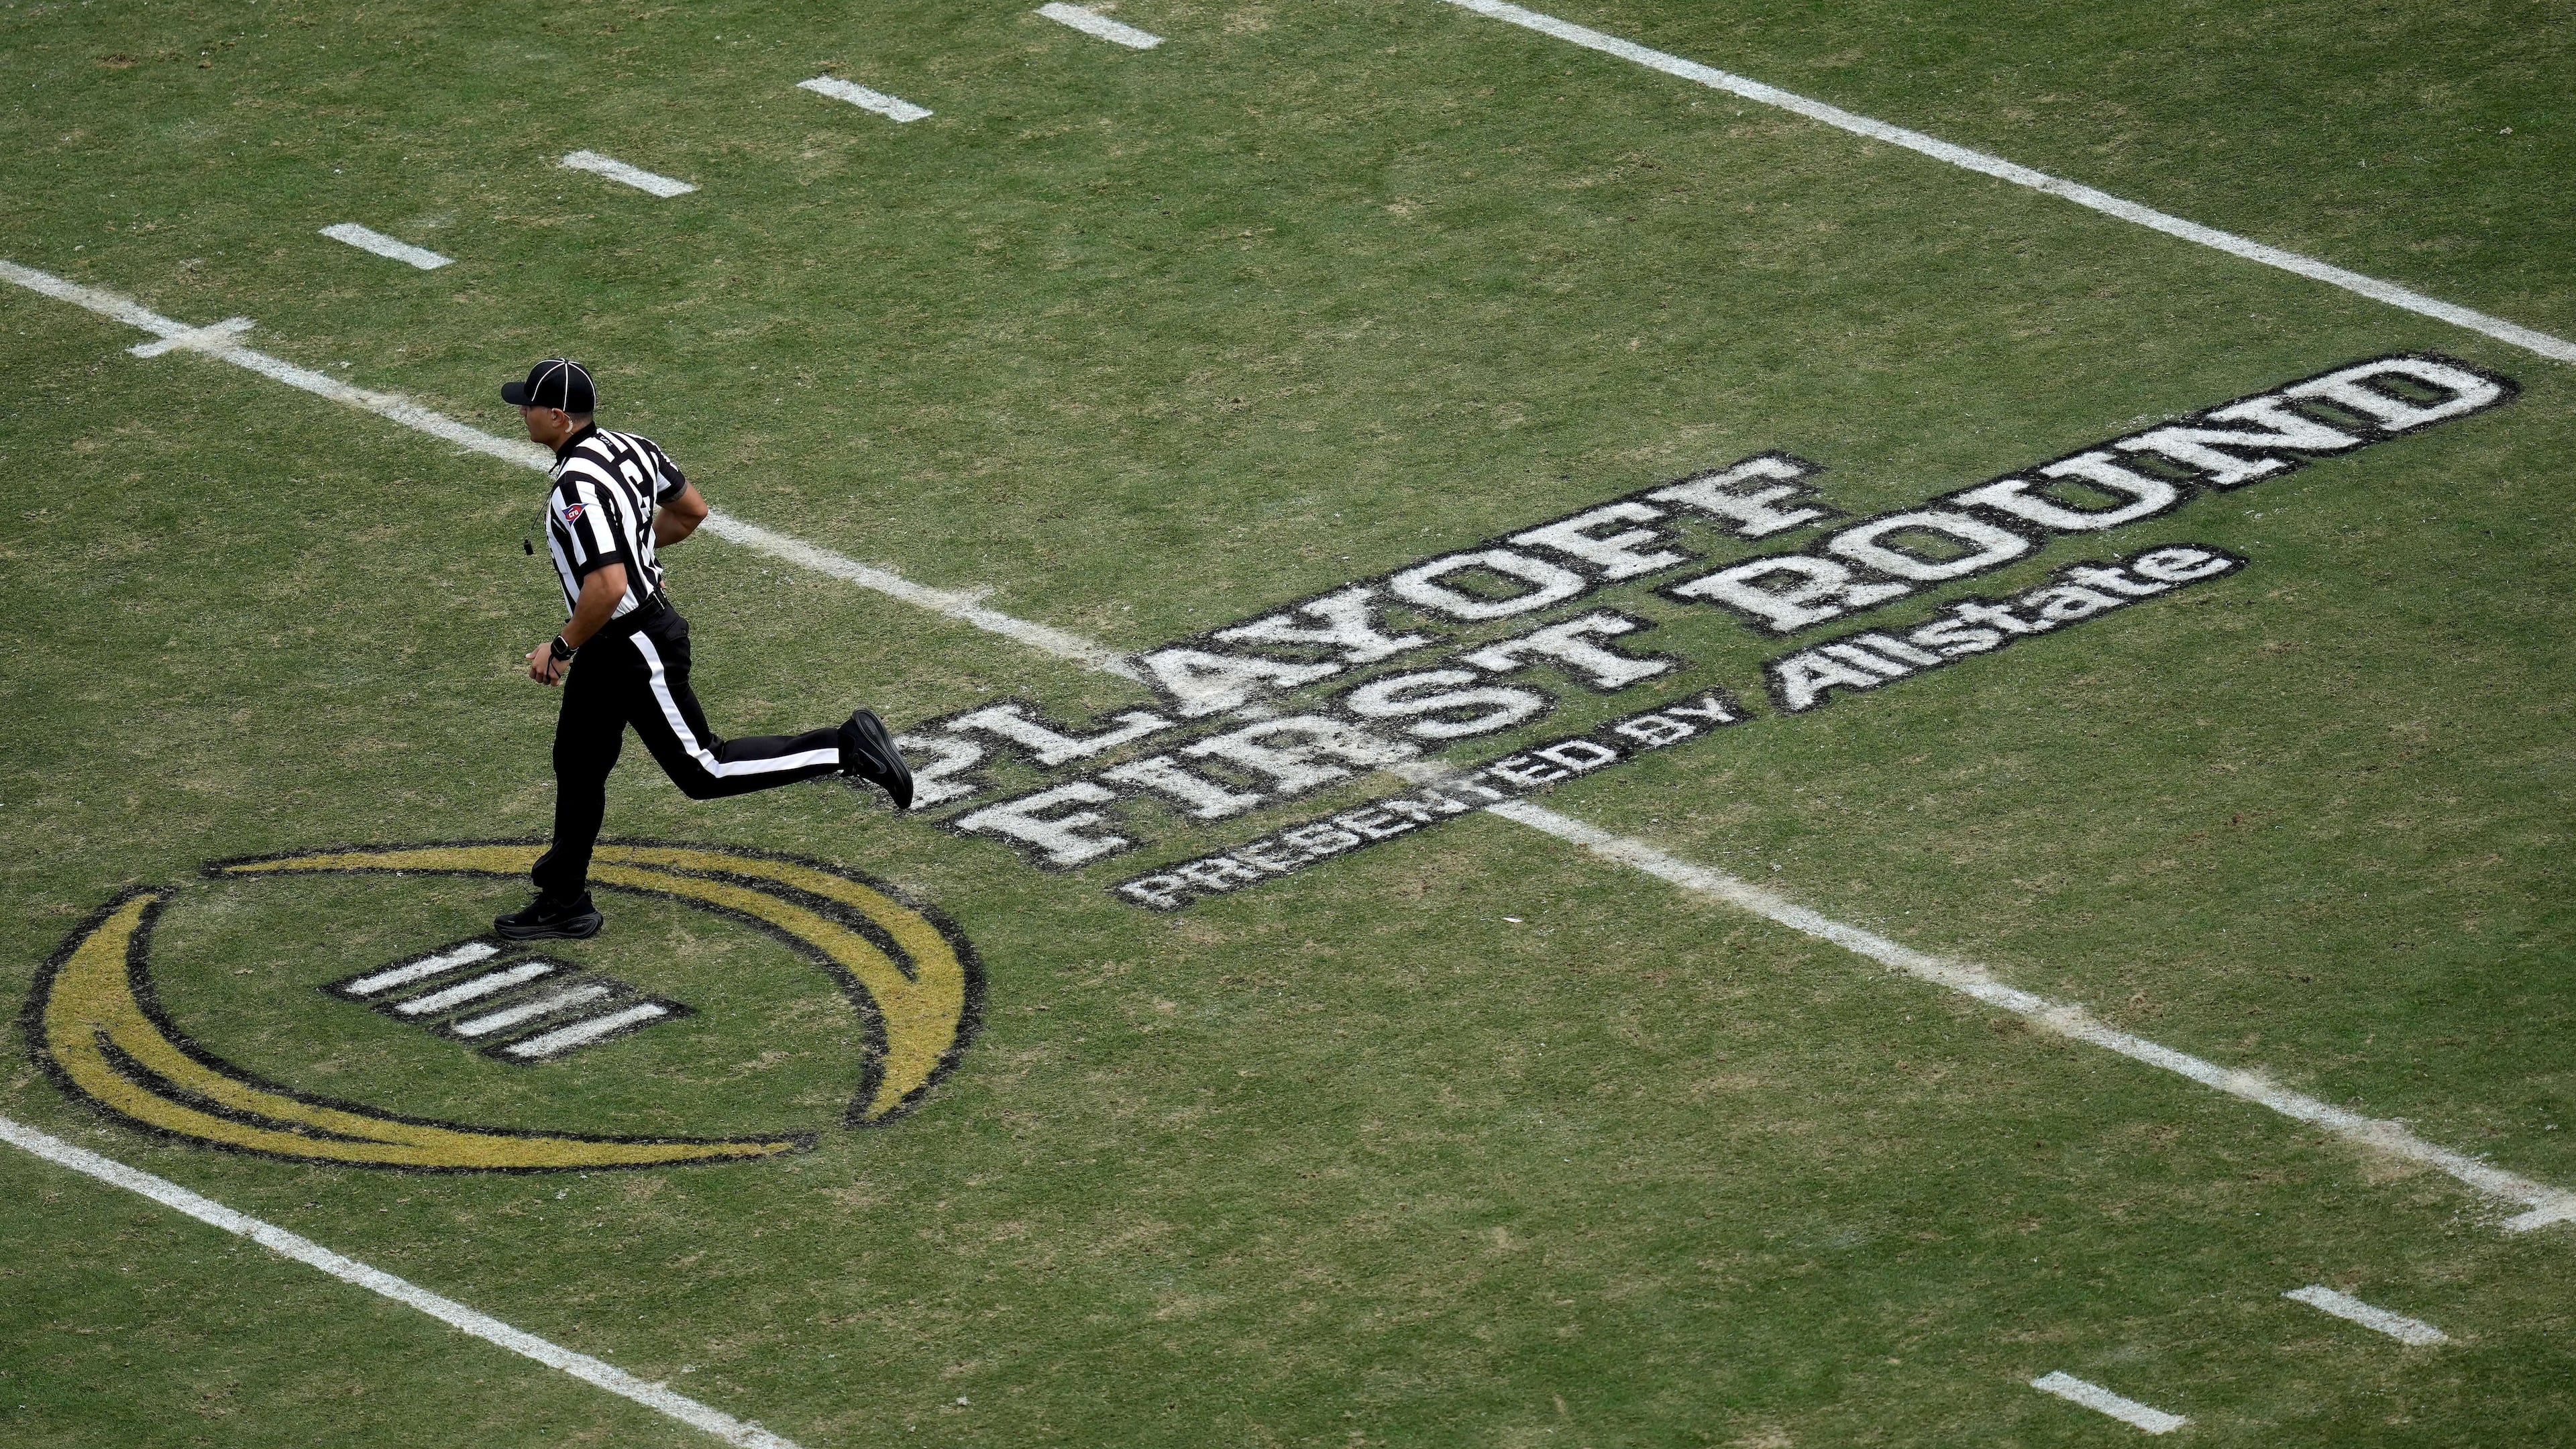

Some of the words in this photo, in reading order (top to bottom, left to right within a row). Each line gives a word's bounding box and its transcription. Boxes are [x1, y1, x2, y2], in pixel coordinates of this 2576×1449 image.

[569, 509, 579, 519] CFO
[955, 612, 1668, 866] FIRST
[1672, 358, 2504, 633] ROUND
[1119, 739, 1618, 910] PRESENTED
[1615, 698, 1735, 746] BY
[1773, 547, 2233, 711] Allstate
